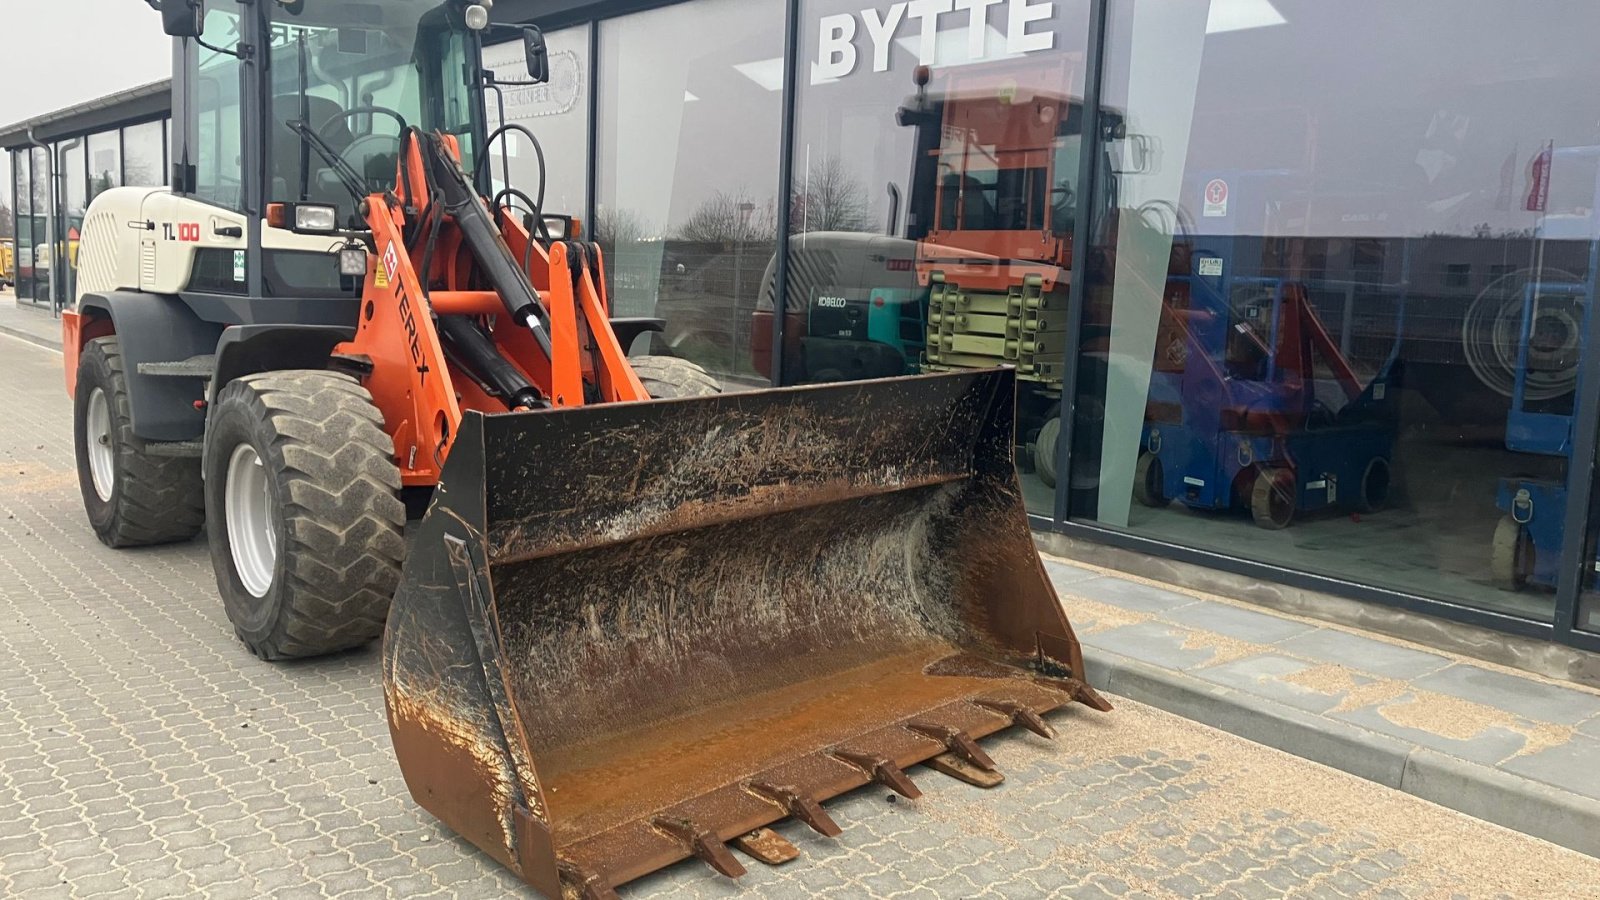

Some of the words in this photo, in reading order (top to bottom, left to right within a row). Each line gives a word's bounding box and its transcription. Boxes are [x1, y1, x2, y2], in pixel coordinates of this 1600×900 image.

[818, 0, 1054, 80] BYTTE
[162, 222, 176, 241] TL
[177, 223, 200, 242] 100
[394, 272, 430, 389] TEREX
